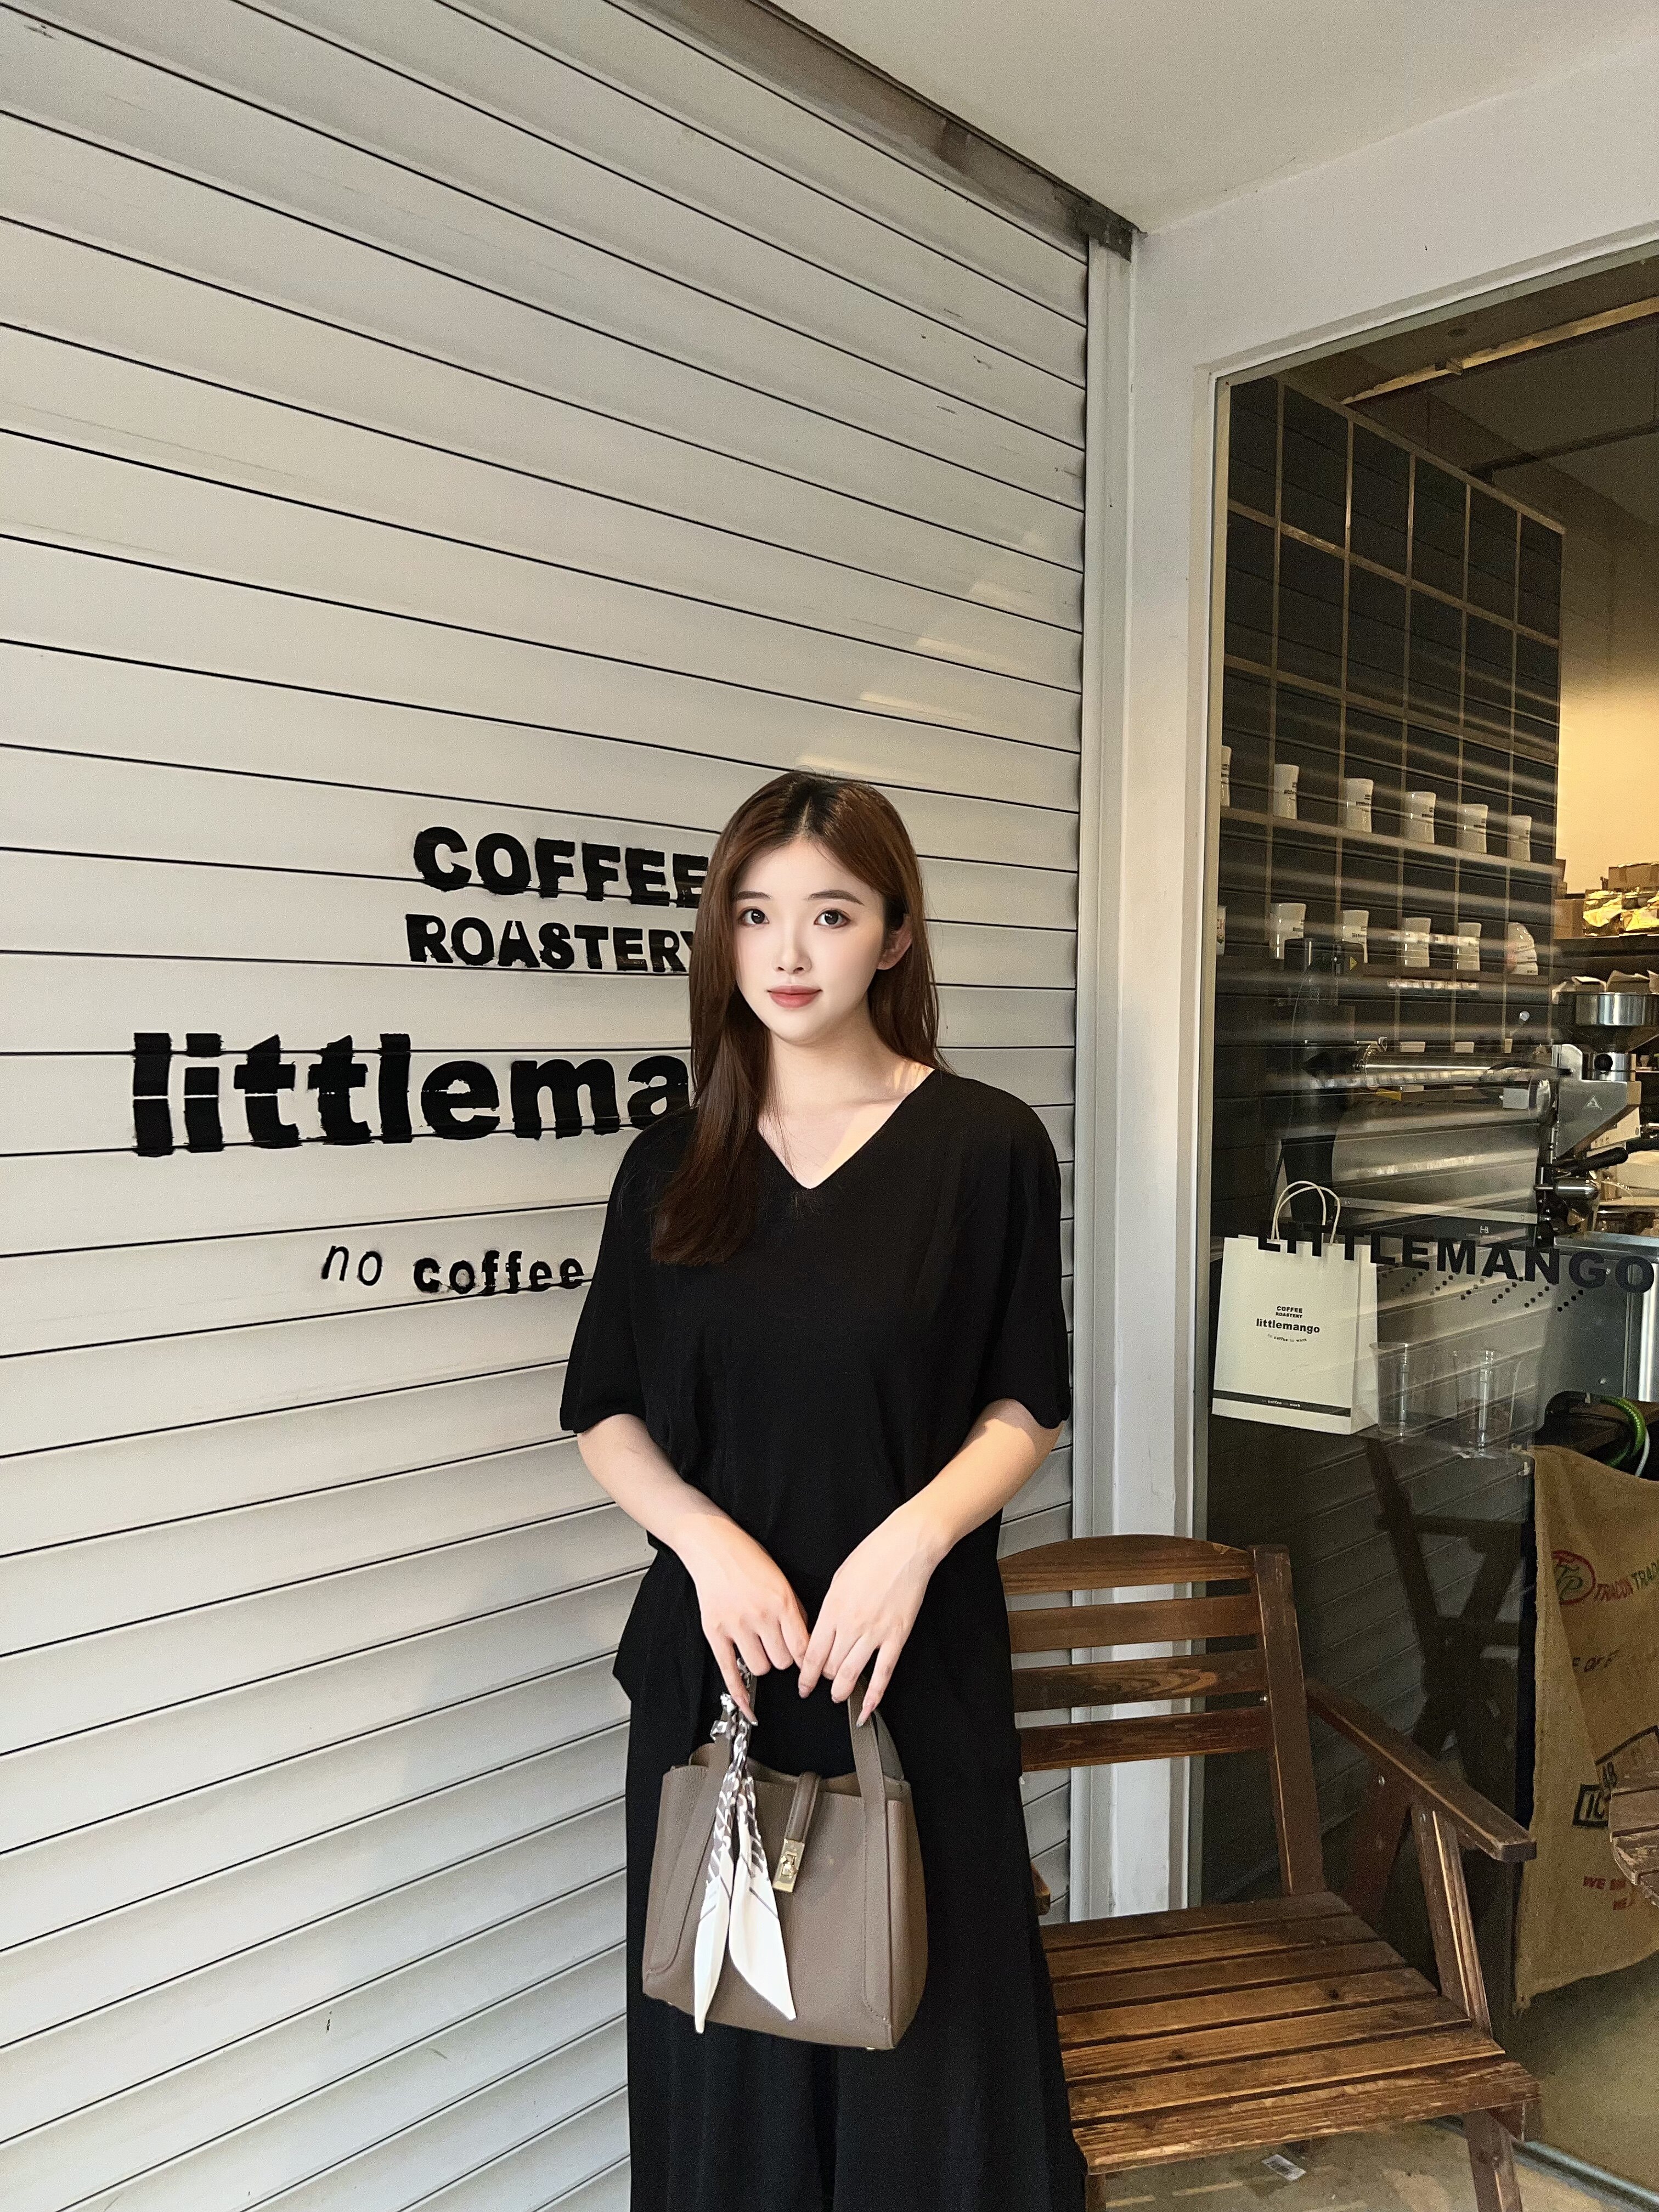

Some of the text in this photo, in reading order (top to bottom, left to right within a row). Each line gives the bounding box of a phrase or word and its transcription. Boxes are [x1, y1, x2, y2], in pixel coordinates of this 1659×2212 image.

[414, 826, 709, 909] COFFEE
[321, 1245, 585, 1296] no coffee
[1258, 1221, 1655, 1294] LITTLEMANGO
[1256, 1318, 1321, 1334] littlemango
